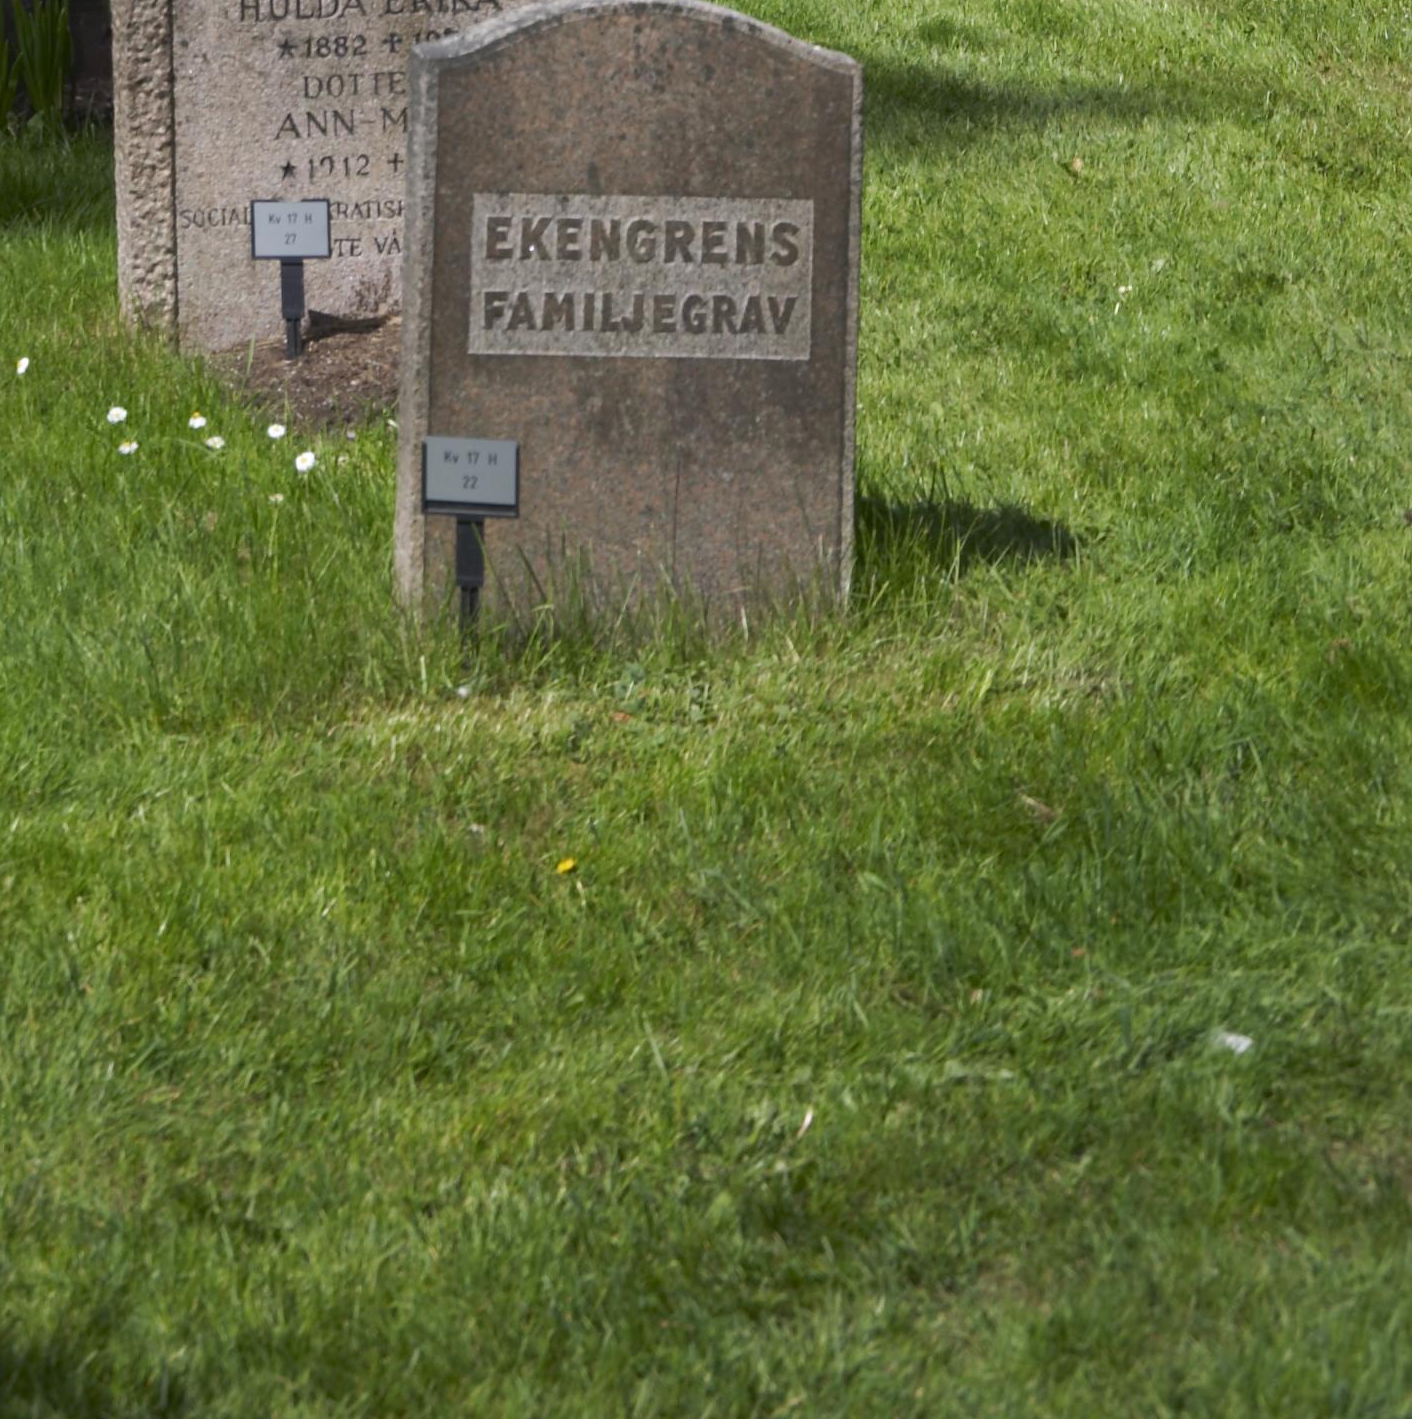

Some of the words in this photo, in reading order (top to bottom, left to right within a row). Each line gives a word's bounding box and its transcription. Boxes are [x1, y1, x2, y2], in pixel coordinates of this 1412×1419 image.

[305, 34, 367, 58] 1882
[309, 154, 370, 180] 1912
[268, 213, 281, 224] Kv
[287, 212, 298, 224] 17
[304, 213, 313, 224] H
[284, 232, 297, 245] 27
[486, 216, 800, 267] EKENGRENS
[482, 291, 798, 334] FAMILJEGRAV
[444, 451, 460, 464] Kv
[468, 450, 480, 465] 17
[488, 453, 498, 466] H
[463, 475, 479, 490] 22
